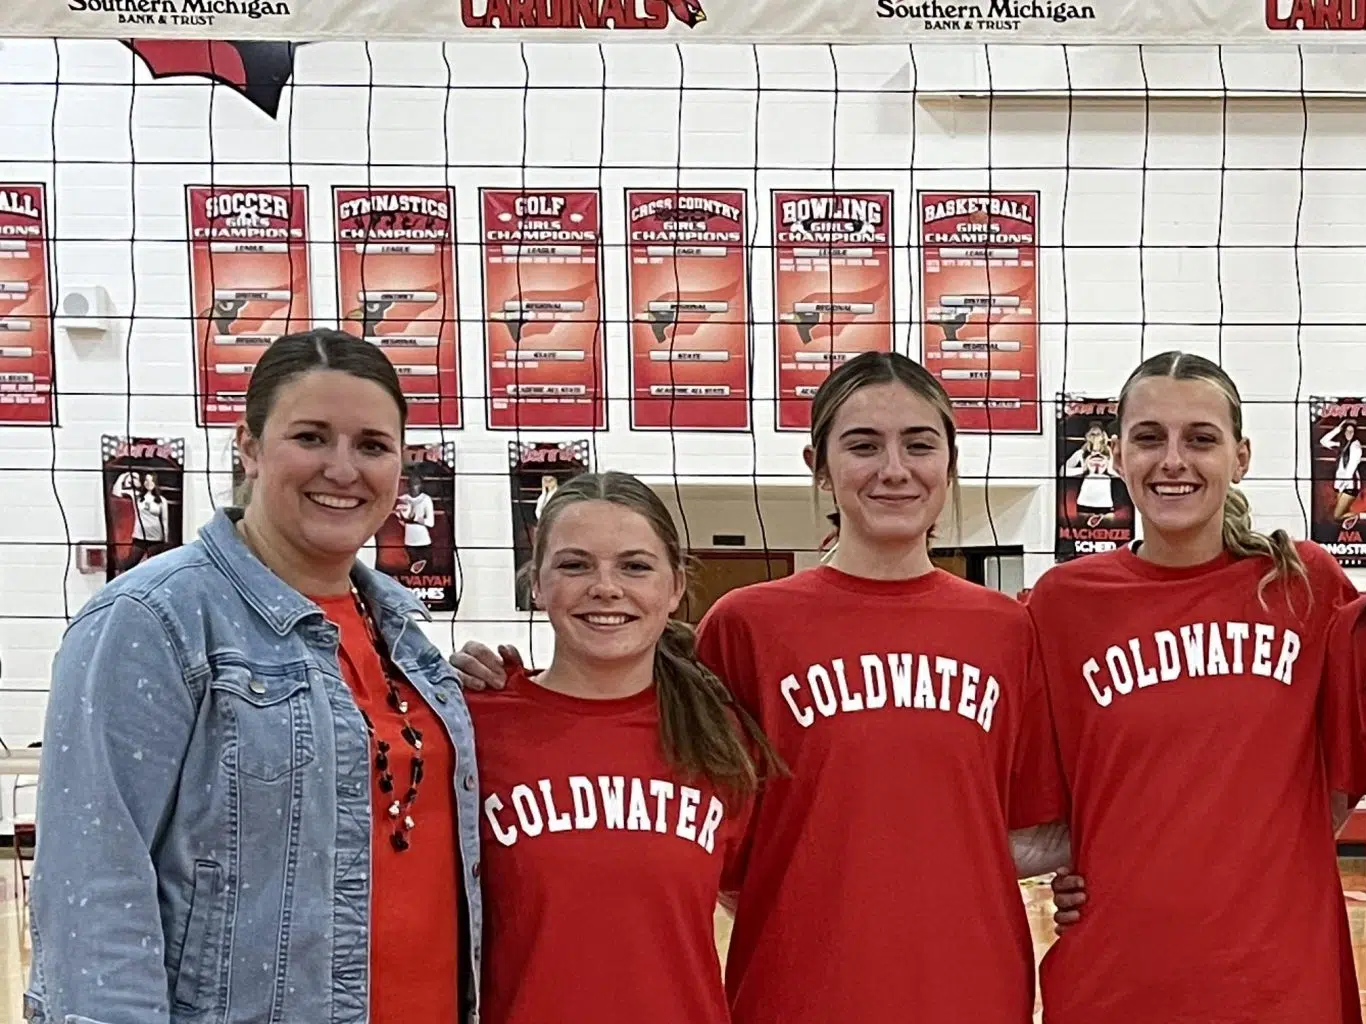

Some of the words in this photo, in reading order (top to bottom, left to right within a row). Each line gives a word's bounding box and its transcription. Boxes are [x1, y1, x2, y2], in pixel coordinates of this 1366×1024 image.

[876, 0, 982, 18] Southern
[986, 0, 1096, 22] Michigan
[118, 14, 155, 24] BANK
[157, 15, 167, 24] &
[170, 15, 215, 26] TRUST
[924, 20, 961, 30] BANK
[963, 20, 973, 30] &
[977, 20, 1021, 30] TRUST
[205, 191, 290, 219] SOCCER
[339, 194, 449, 220] GYMNASTICS
[514, 196, 566, 217] GOLF
[631, 197, 673, 221] CROSS
[679, 196, 741, 221] COUNTRY
[781, 197, 882, 224] BOWLING
[924, 197, 1033, 223] BASKETBALL
[663, 221, 707, 231] GIRLS
[810, 222, 854, 232] GIRLS
[956, 223, 1000, 233] GIRLS
[193, 228, 303, 238] CHAMPIONS
[340, 229, 448, 239] CHAMPIONS
[486, 230, 595, 241] CHAMPIONS
[631, 230, 741, 242] CHAMPIONS
[778, 232, 886, 242] CHAMPIONS
[925, 233, 1033, 243] CHAMPIONS
[1082, 621, 1300, 707] COLDWATER
[781, 653, 1000, 733] COLDWATER
[485, 776, 725, 854] COLDWATER
